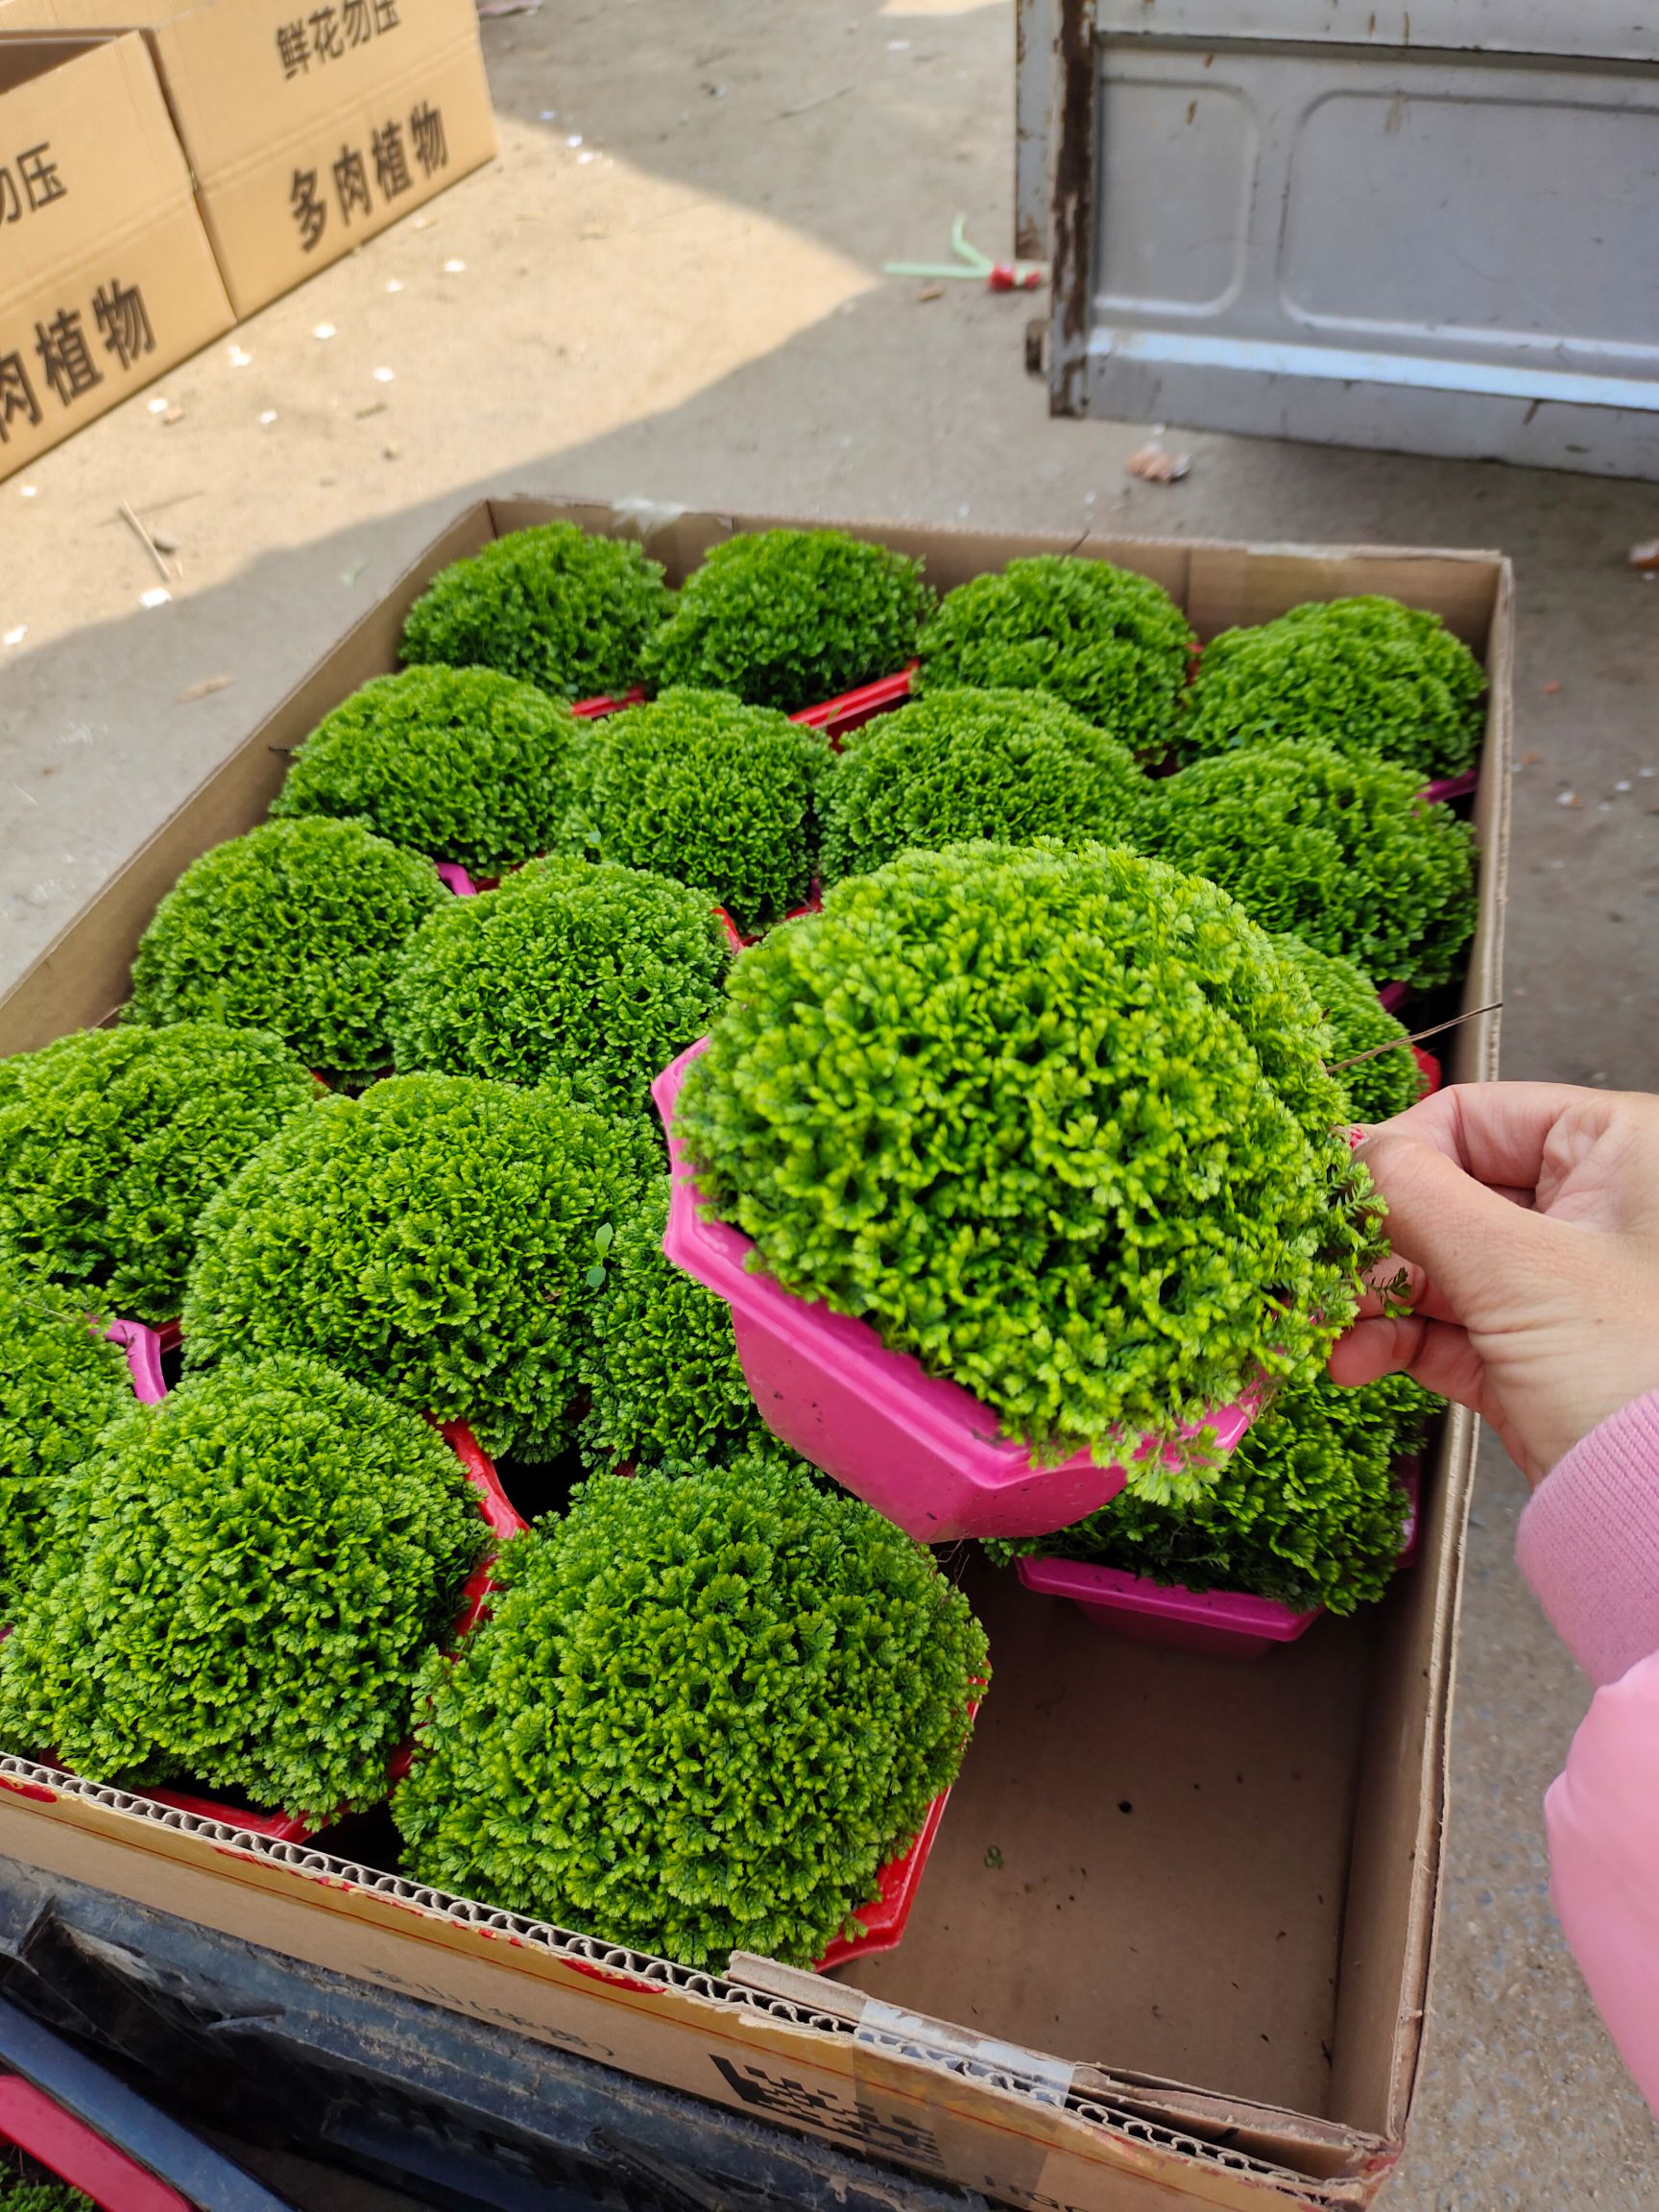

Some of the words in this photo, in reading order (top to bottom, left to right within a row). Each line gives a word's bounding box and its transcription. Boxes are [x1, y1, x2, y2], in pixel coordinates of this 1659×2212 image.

[276, 0, 401, 81] 鲜花勿压
[289, 101, 449, 254] 多肉植物
